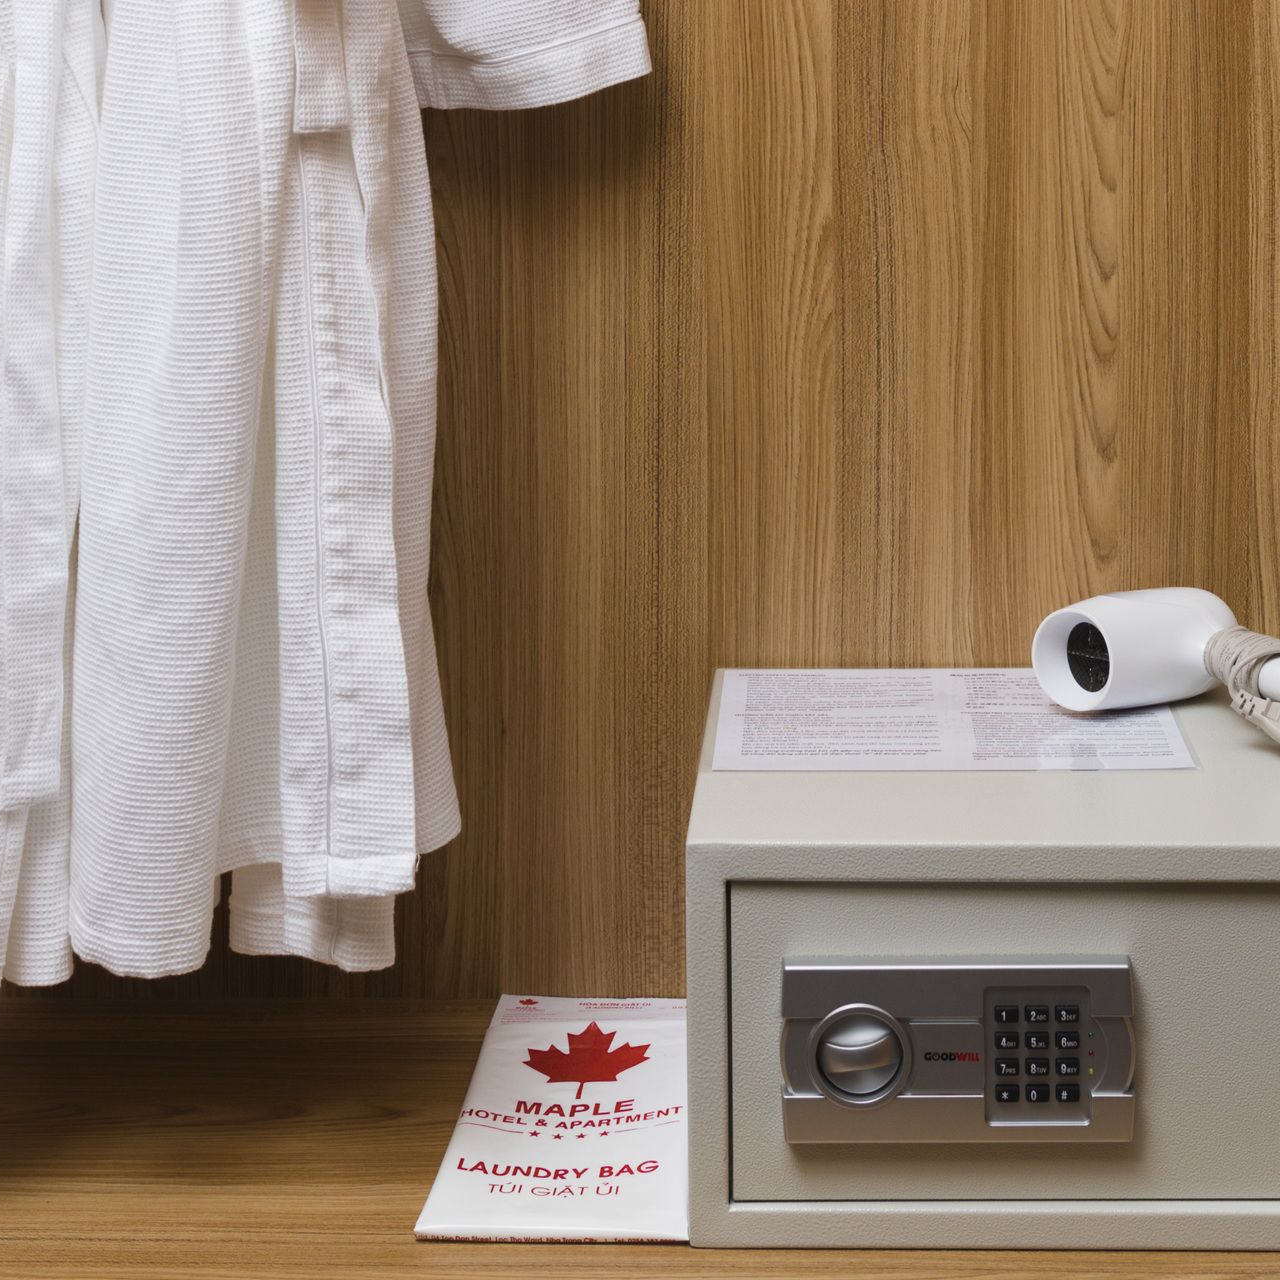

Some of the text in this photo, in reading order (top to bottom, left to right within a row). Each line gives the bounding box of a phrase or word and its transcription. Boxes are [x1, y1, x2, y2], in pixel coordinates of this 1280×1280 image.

[1000, 1010, 1007, 1022] 1
[923, 1052, 981, 1062] GOODWILL
[1030, 1090, 1037, 1101] 0
[514, 1099, 636, 1117] MAPLE
[460, 1106, 684, 1129] HOTEL & APARTMENT
[456, 1157, 660, 1180] LAUNDRY BAG
[488, 1181, 524, 1194] TÚI
[595, 1181, 620, 1196] ỦI
